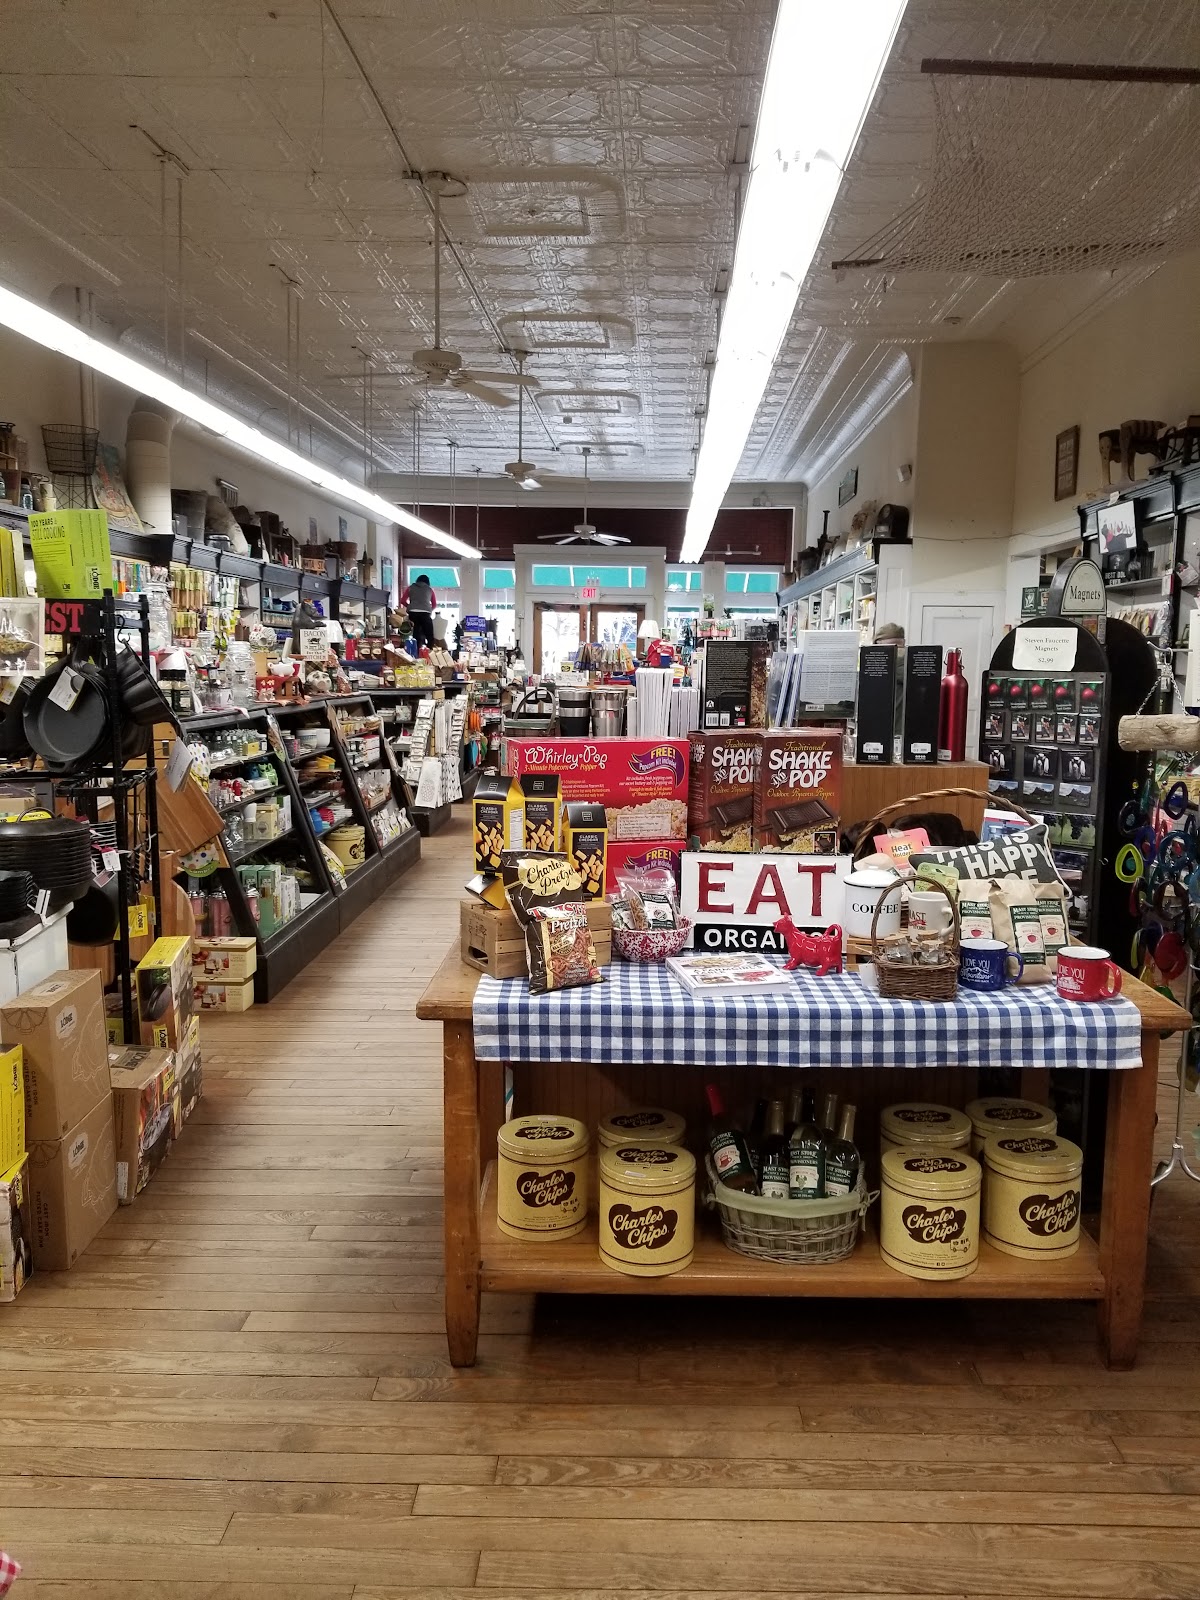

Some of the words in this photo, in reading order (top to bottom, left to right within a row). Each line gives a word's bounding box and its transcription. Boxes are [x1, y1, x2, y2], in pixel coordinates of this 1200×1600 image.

[39, 517, 54, 526] YEARS
[582, 588, 596, 599] EXIT
[1069, 585, 1101, 603] Magnets
[303, 630, 326, 638] BACON
[783, 740, 827, 751] Traditional
[650, 746, 676, 760] FREE!
[711, 746, 755, 767] SHAK
[768, 748, 834, 770] SHAKE
[548, 764, 569, 772] Popcorn
[580, 764, 598, 772] Popper
[789, 769, 827, 788] POP
[766, 788, 789, 797] Outdoor
[791, 788, 814, 800] Popcorn
[814, 788, 835, 800] Popper
[891, 843, 913, 853] Heat
[645, 849, 672, 862] FREE!
[963, 842, 1053, 880] HAPPY
[526, 859, 565, 884] Charles
[696, 861, 837, 917] EAT
[852, 902, 899, 915] COFFEE
[551, 917, 588, 934] Pretzels
[978, 959, 991, 969] YOU
[1070, 967, 1085, 980] YOU
[1004, 1138, 1042, 1149] Charles
[1021, 1142, 1051, 1151] Chips
[621, 1149, 665, 1158] Charles
[635, 1154, 668, 1163] Chips
[801, 1150, 818, 1158] STORE
[911, 1156, 943, 1167] Chips
[919, 1161, 961, 1173] Charles
[834, 1167, 851, 1176] STORE
[521, 1172, 565, 1195] Charles
[535, 1184, 569, 1206] Chips
[1026, 1192, 1075, 1222] Charles
[612, 1210, 663, 1232] Charles
[906, 1209, 955, 1229] Charles
[1044, 1206, 1077, 1233] Chips
[627, 1223, 670, 1246] Chips
[922, 1222, 960, 1241] Chips
